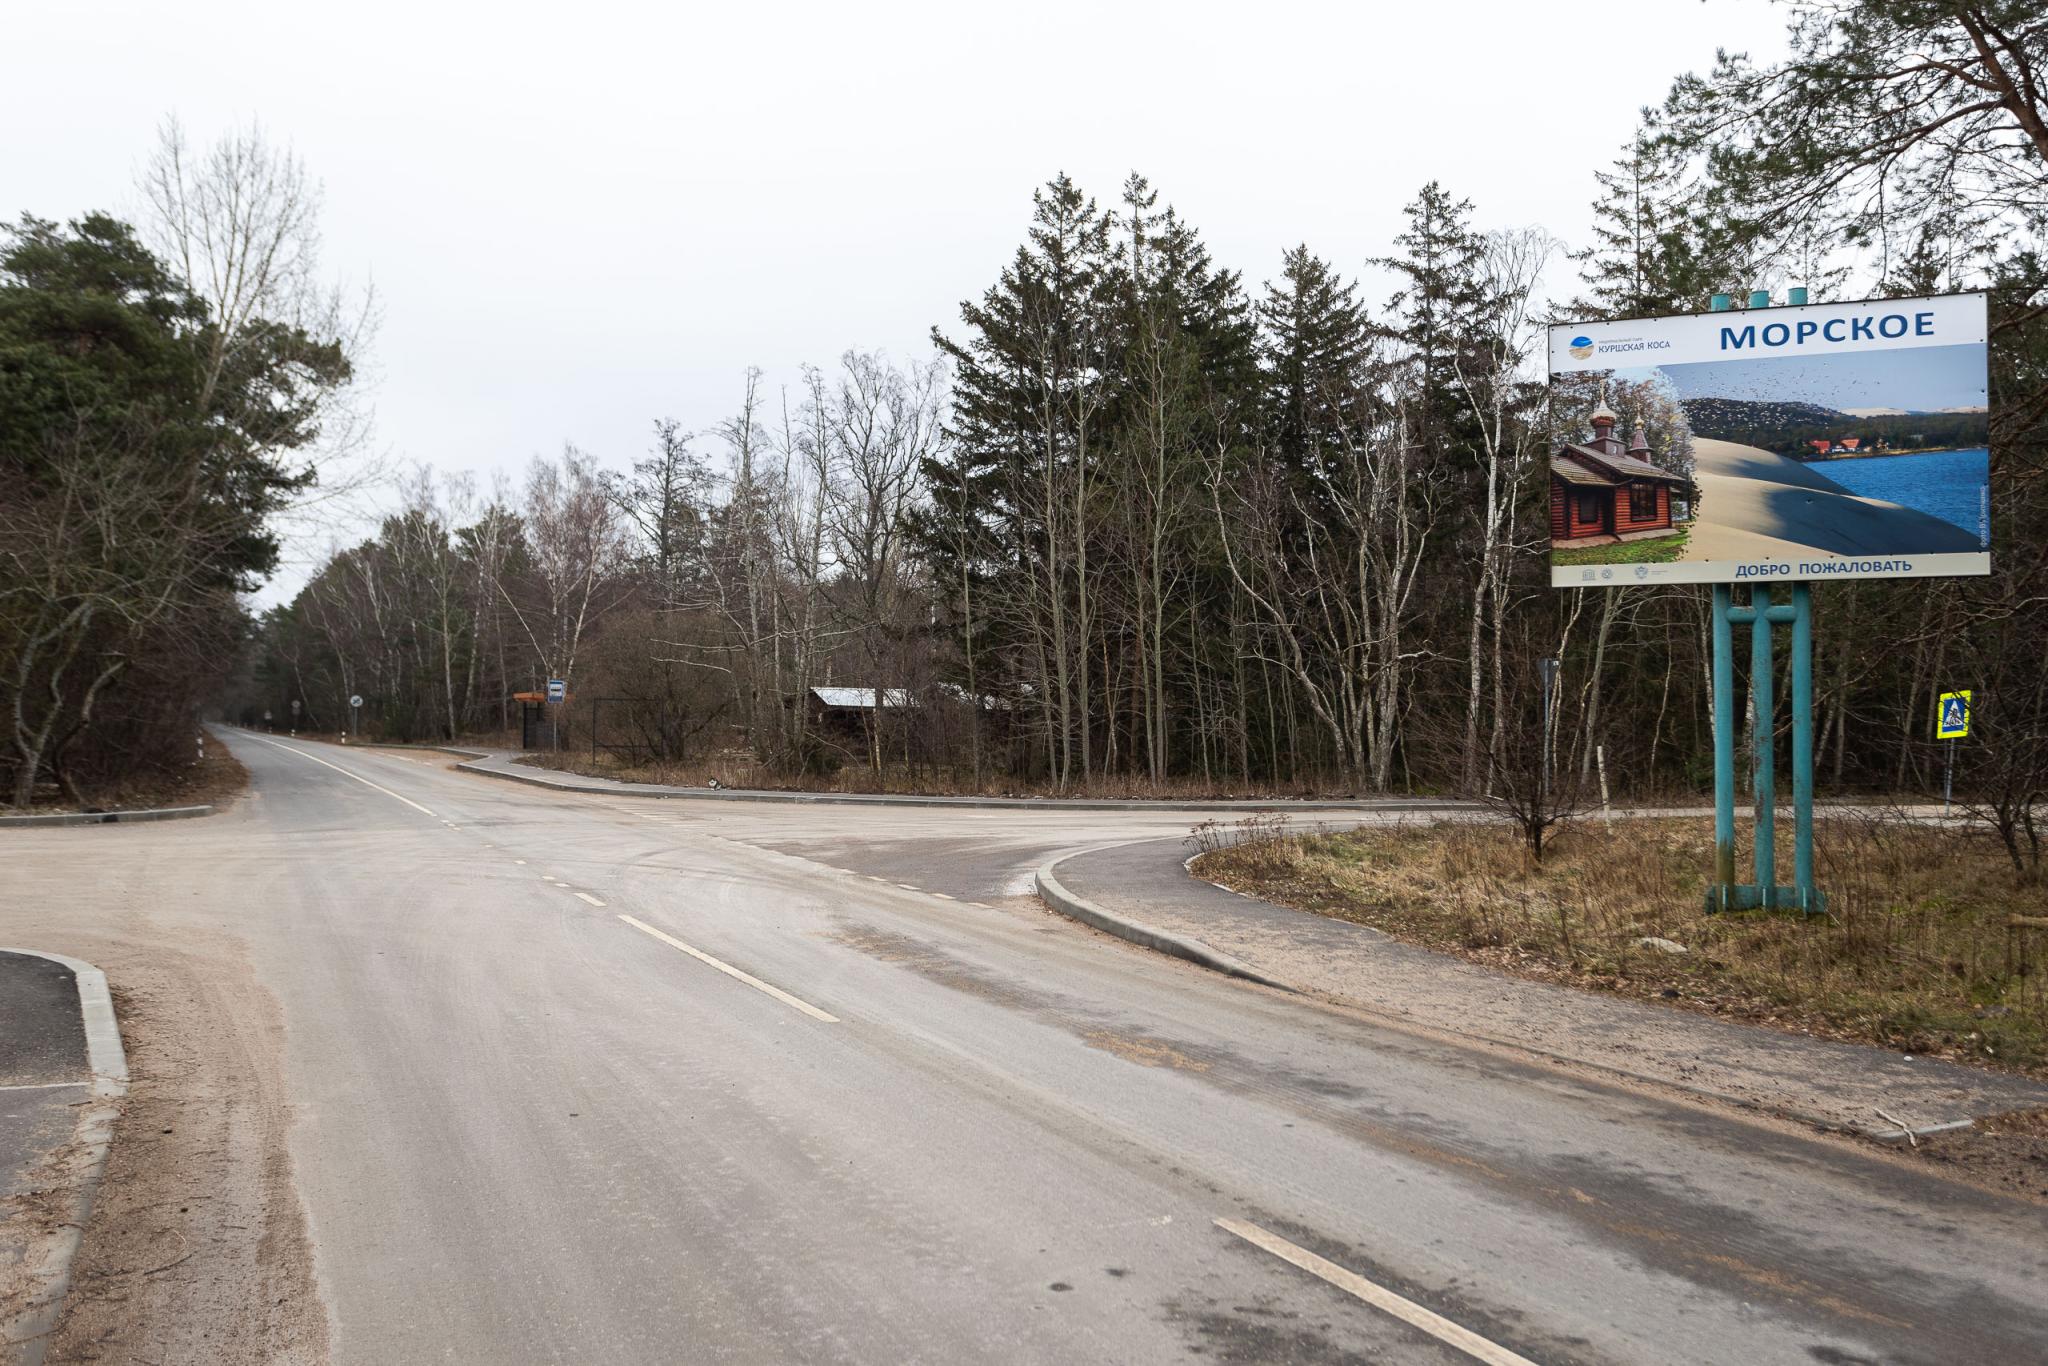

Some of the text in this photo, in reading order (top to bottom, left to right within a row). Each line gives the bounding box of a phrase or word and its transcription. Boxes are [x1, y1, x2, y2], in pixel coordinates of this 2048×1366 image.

[1720, 311, 1935, 350] МОРСКОЕ
[1598, 341, 1670, 353] КУРШСКАЯ КОСА
[1735, 560, 1913, 579] ДОБРО ПОЖАЛОВАТЬ
